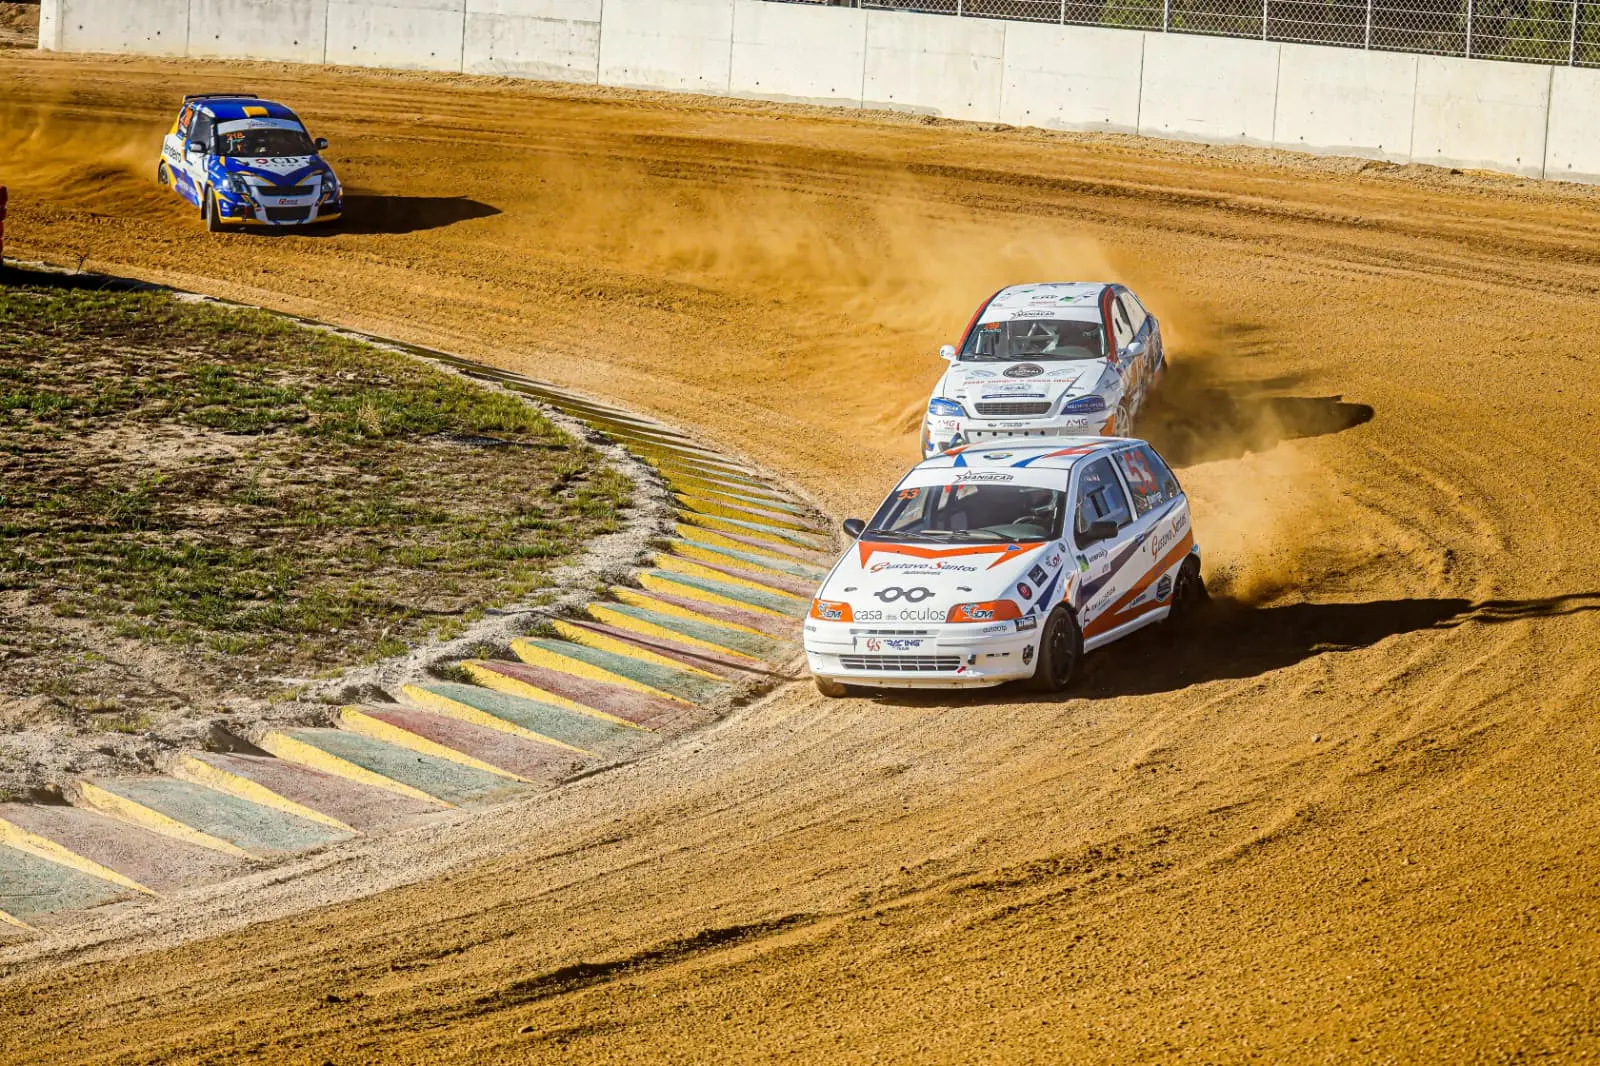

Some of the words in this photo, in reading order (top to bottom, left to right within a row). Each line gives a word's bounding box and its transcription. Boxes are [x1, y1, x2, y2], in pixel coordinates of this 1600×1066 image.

[962, 473, 1014, 481] MANIACAR
[1123, 450, 1158, 494] 53
[897, 488, 920, 500] 53
[1151, 530, 1173, 560] Gustavo
[870, 561, 928, 573] Gustavo
[929, 561, 977, 572] Santos
[854, 610, 882, 620] casa
[900, 608, 946, 621] óculos
